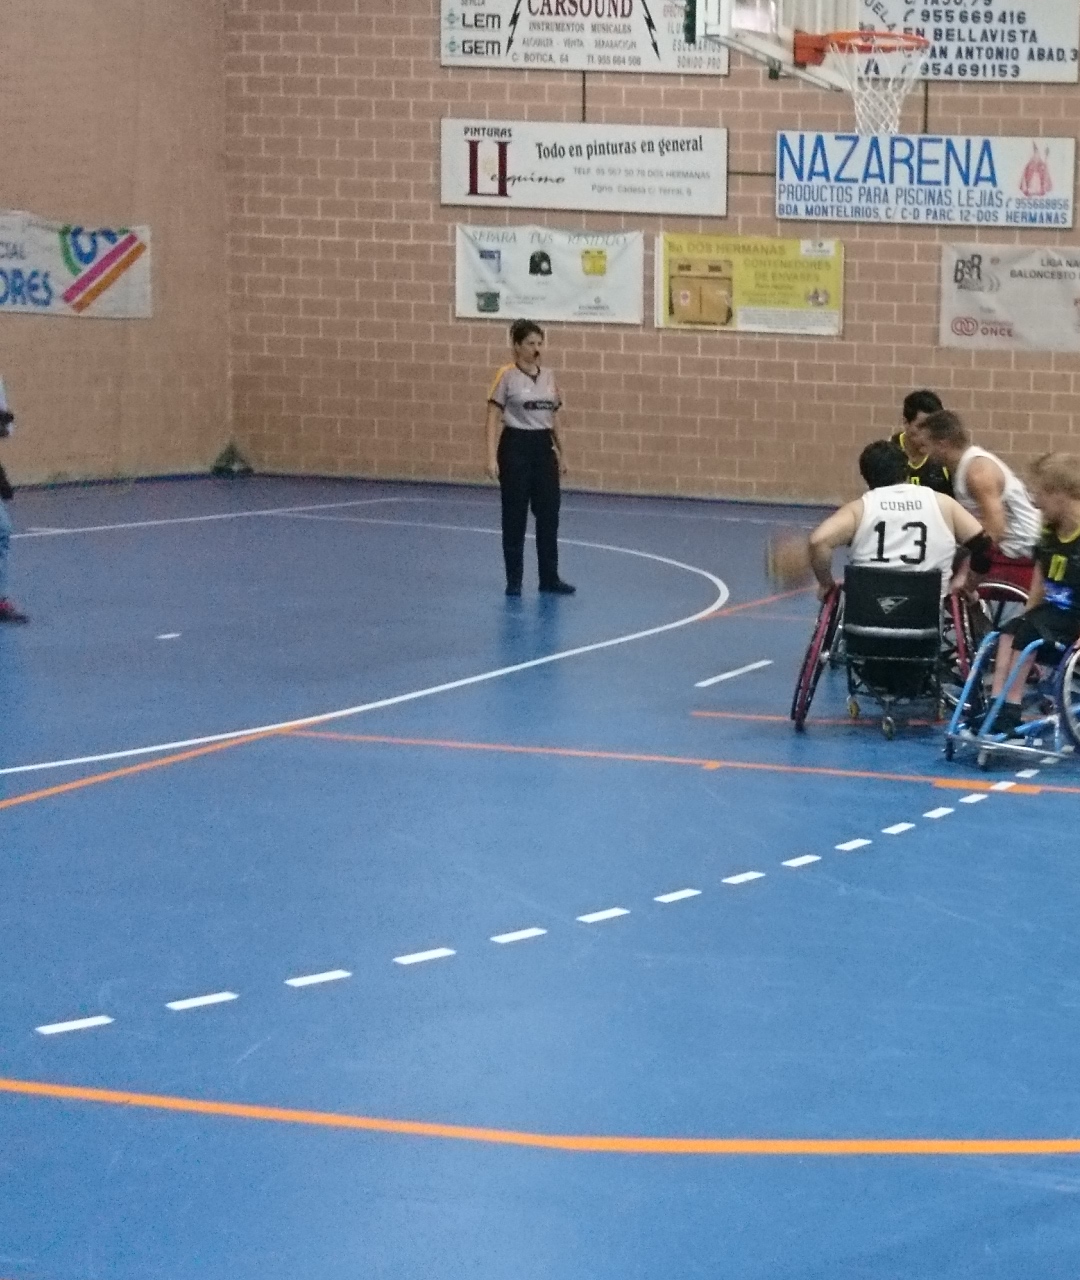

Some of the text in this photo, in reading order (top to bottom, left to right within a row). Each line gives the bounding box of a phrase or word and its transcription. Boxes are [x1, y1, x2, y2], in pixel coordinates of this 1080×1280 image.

[461, 12, 501, 30] LEM
[528, 22, 632, 34] INSTRUMENTOS MUSICALES
[933, 28, 1038, 43] BELLAVISTA
[461, 39, 501, 56] GEM
[955, 47, 1020, 61] ANTONIO
[463, 127, 513, 138] PINTURAS
[536, 134, 704, 161] Todo en pinturas en general
[778, 132, 999, 188] NAZARENA
[778, 183, 853, 203] PRODUCTOS
[858, 186, 889, 205] PARA
[957, 189, 1004, 209] LEJIAS
[1005, 210, 1068, 225] HERMANAS
[471, 230, 517, 243] SEPARA
[530, 231, 553, 244] TUS
[686, 242, 712, 254] DOS
[716, 243, 787, 256] HERMANAS
[1009, 269, 1076, 280] BALONCESTO
[980, 326, 1013, 337] ONCE
[869, 520, 928, 565] 13
